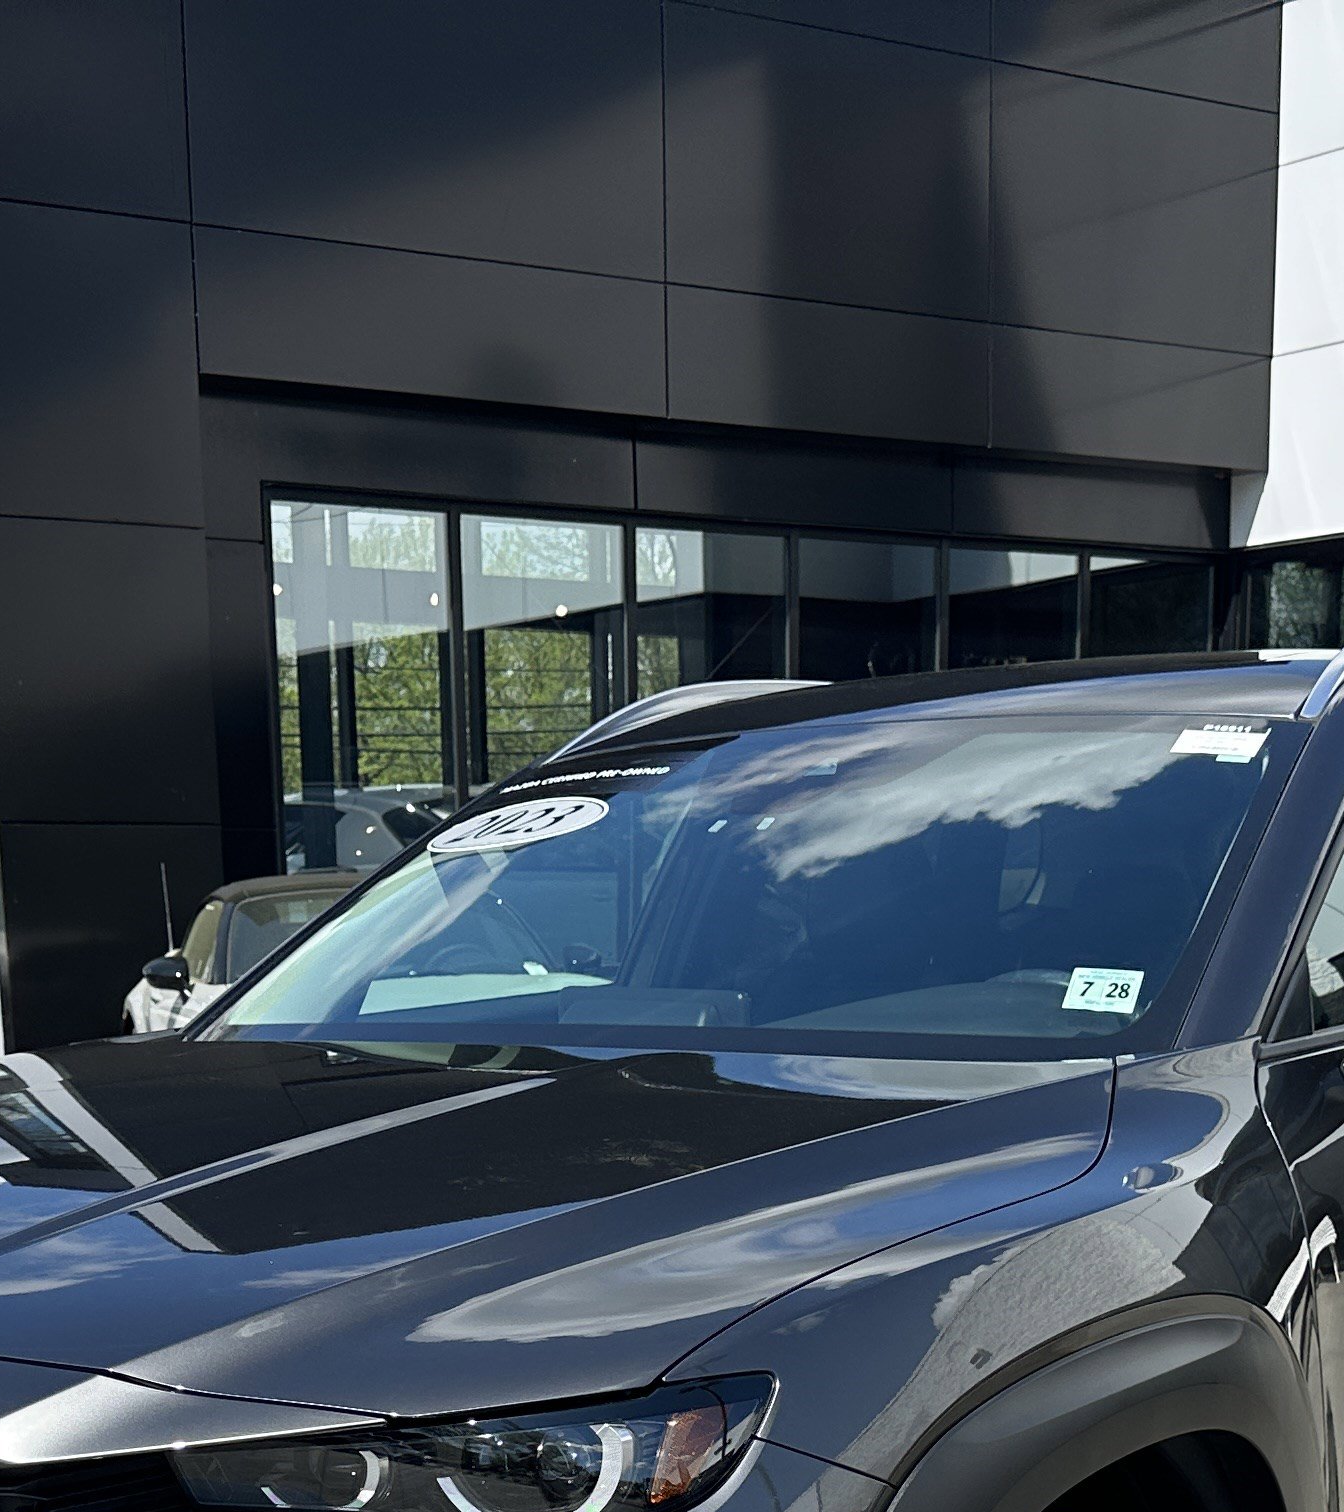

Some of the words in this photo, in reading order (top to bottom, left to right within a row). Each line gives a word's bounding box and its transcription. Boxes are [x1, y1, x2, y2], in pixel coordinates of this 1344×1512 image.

[442, 805, 585, 845] 2023
[1080, 981, 1095, 997] 7
[1105, 983, 1130, 998] 28
